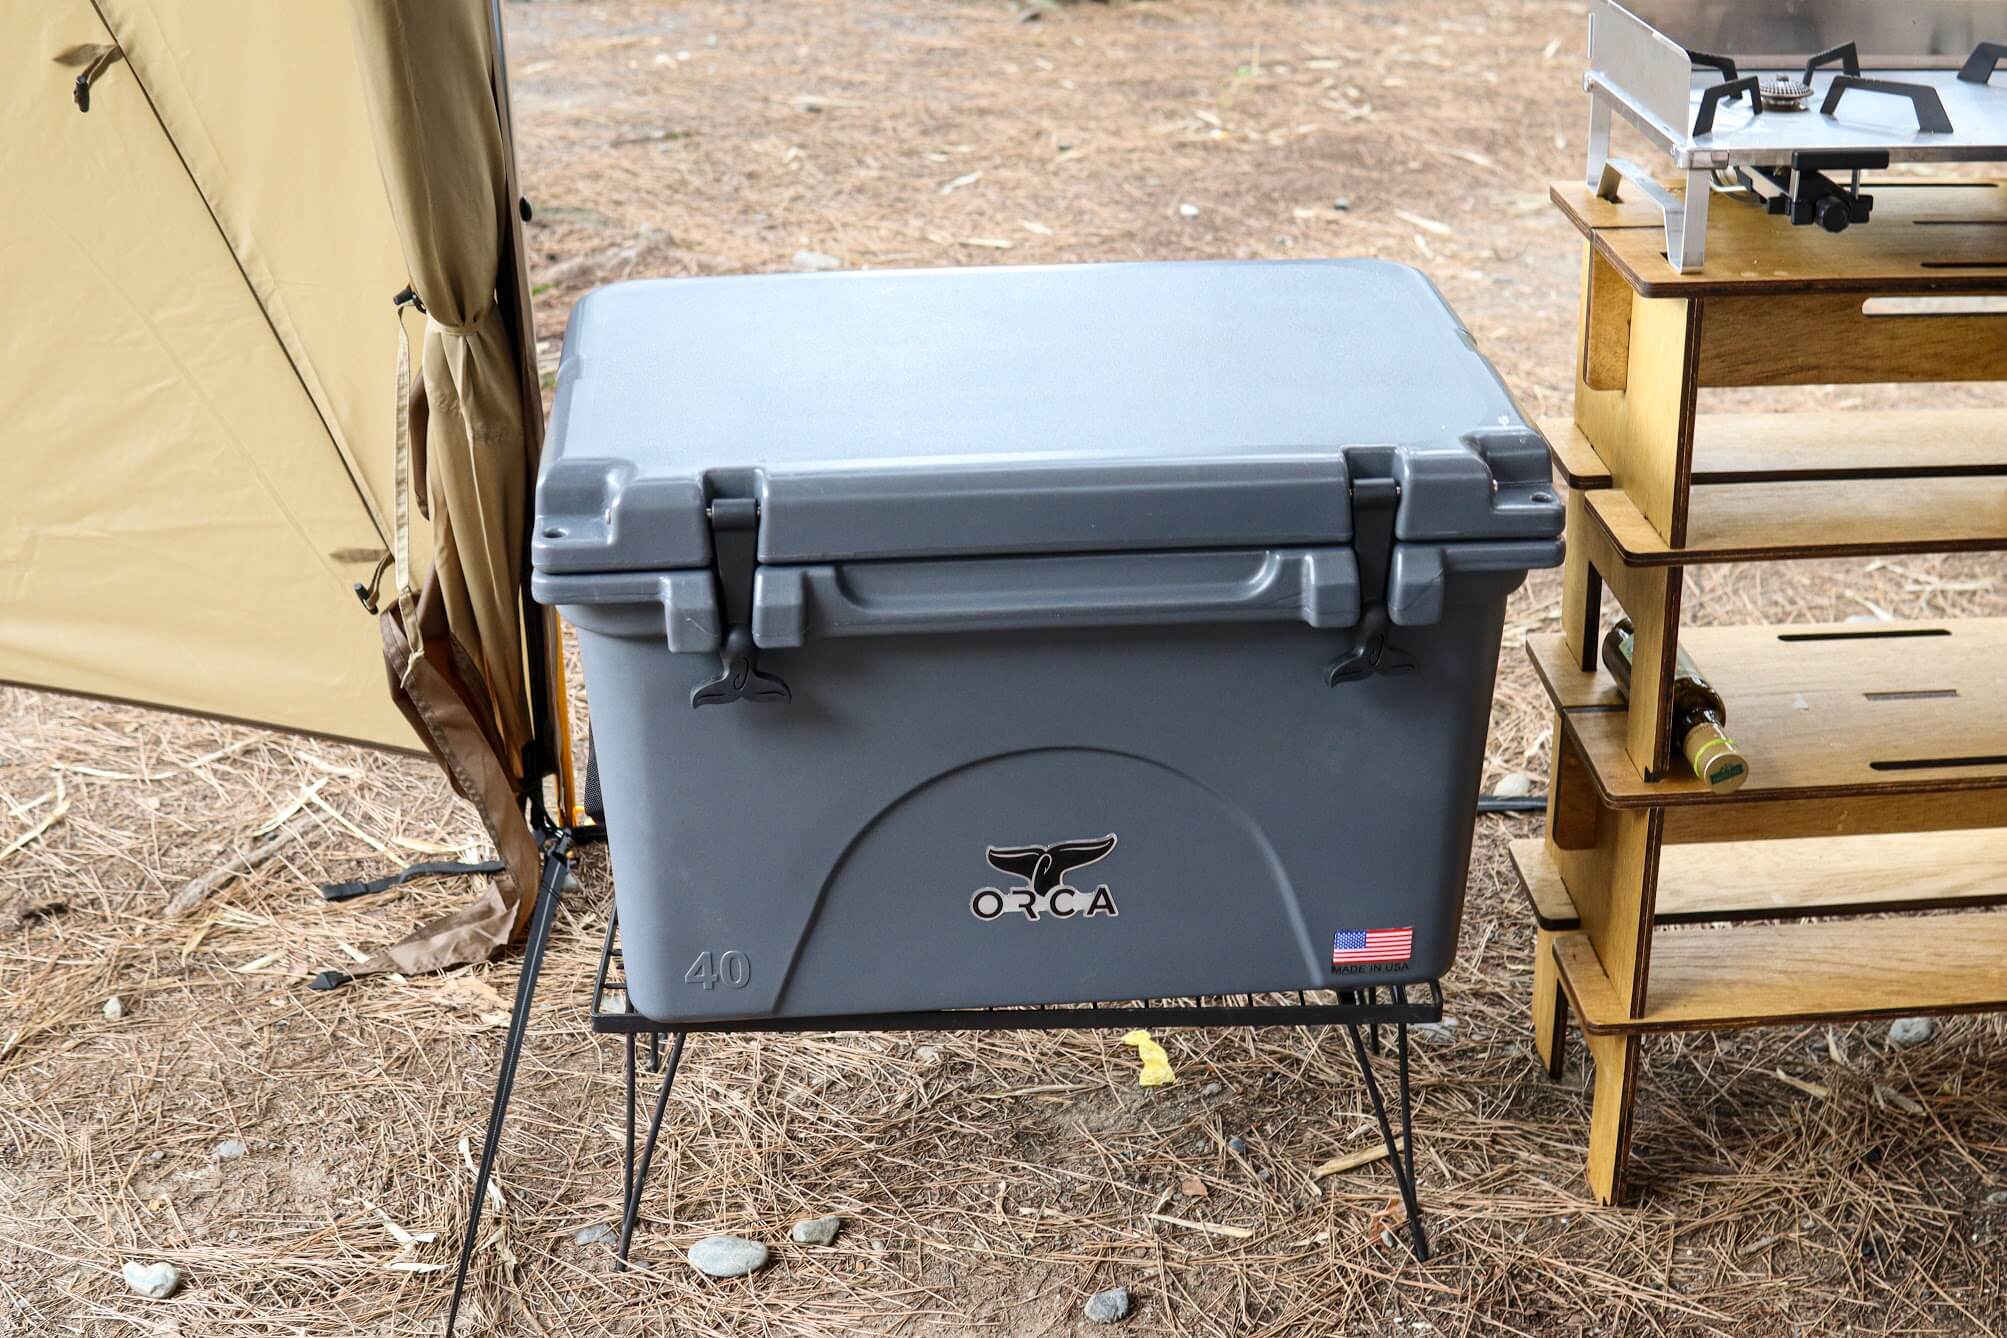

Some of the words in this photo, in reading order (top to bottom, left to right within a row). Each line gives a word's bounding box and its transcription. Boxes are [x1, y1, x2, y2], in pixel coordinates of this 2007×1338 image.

[972, 886, 1117, 919] ORCA
[684, 950, 751, 990] 40
[1332, 964, 1365, 974] MADE
[1370, 963, 1381, 973] IN
[1385, 962, 1409, 972] USA
